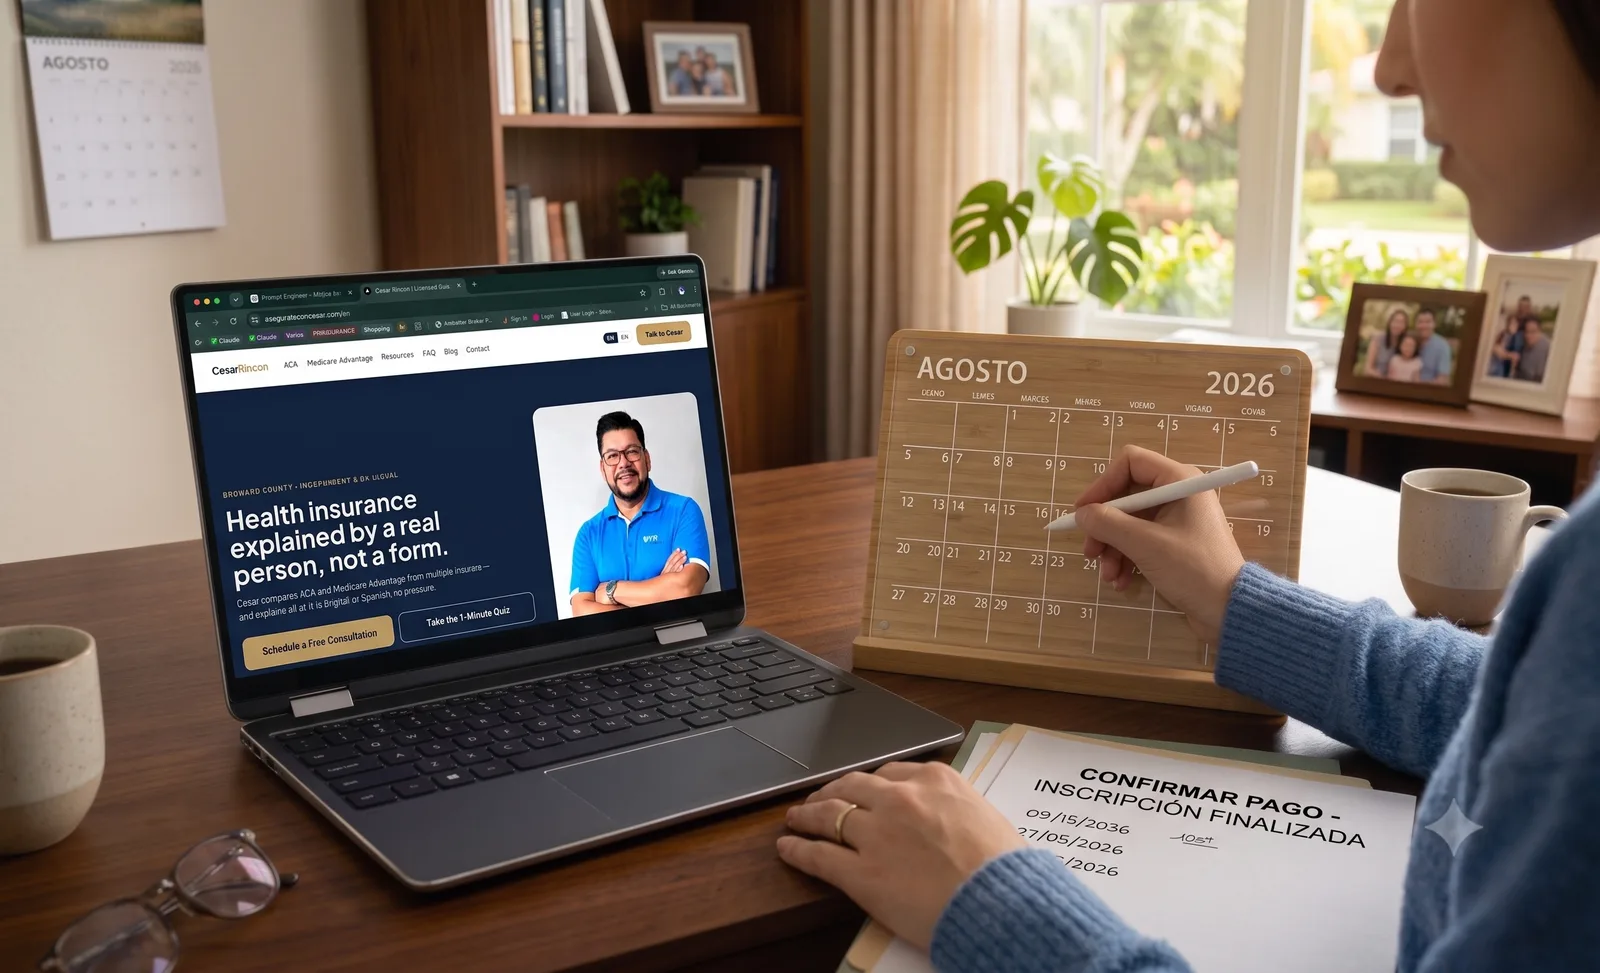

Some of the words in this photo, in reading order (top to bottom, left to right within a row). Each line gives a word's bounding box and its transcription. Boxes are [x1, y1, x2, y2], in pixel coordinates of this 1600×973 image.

[43, 56, 109, 71] AGOSTO
[283, 292, 308, 300] Engineer
[391, 285, 410, 293] Rincon
[218, 336, 240, 344] Claude
[256, 333, 277, 341] Claude
[285, 331, 304, 339] Varios
[363, 325, 391, 333] Shopping
[307, 358, 337, 366] Medicare
[339, 355, 373, 364] Advantage
[381, 351, 414, 360] Resources
[422, 349, 436, 357] FAQ
[444, 348, 458, 356] Blog
[465, 345, 490, 353] Contact
[212, 363, 269, 375] CesarRincon
[917, 356, 1027, 384] AGOSTO
[1205, 371, 1274, 397] 2026
[972, 392, 995, 400] LEMES
[1021, 394, 1049, 403] MARCES
[1049, 411, 1056, 423] 2
[1063, 412, 1070, 423] 2
[1102, 415, 1109, 426] 3
[1117, 416, 1123, 427] 3
[1157, 419, 1164, 430] 4
[1172, 419, 1178, 431] 5
[1212, 423, 1220, 433] 4
[1228, 423, 1235, 434] 5
[1270, 426, 1277, 437] 5
[904, 449, 911, 460] 5
[942, 452, 949, 463] 6
[956, 453, 963, 464] 7
[993, 456, 1000, 467] 8
[1006, 456, 1013, 467] 8
[1045, 459, 1052, 470] 9
[1059, 460, 1066, 471] 9
[1093, 463, 1106, 474] 10
[1260, 475, 1274, 486] 13
[222, 488, 260, 498] BROWARD
[262, 484, 293, 494] COUNTY
[226, 503, 304, 532] Health
[308, 493, 417, 522] insurance
[901, 496, 914, 507] 12
[933, 499, 945, 510] 13
[952, 500, 965, 511] 14
[984, 503, 996, 514] 14
[1003, 504, 1015, 515] 15
[1035, 507, 1048, 518] 16
[1257, 525, 1270, 537] 19
[230, 523, 345, 560] explained
[349, 522, 378, 546] by
[382, 521, 396, 538] a
[399, 510, 441, 536] real
[234, 559, 324, 592] person,
[329, 549, 368, 572] not
[372, 549, 385, 566] a
[388, 541, 448, 563] form.
[896, 542, 910, 554] 20
[927, 545, 941, 557] 20
[947, 547, 959, 558] 21
[978, 549, 990, 561] 21
[998, 551, 1012, 563] 22
[1030, 554, 1044, 566] 23
[1050, 556, 1065, 567] 23
[1083, 558, 1097, 570] 24
[236, 598, 259, 608] Cesar
[260, 592, 299, 604] compares
[300, 588, 316, 598] ACA
[317, 586, 331, 596] and
[333, 581, 367, 593] Medicare
[368, 575, 406, 588] Advantage
[407, 573, 424, 582] from
[425, 567, 454, 579] multiple
[239, 611, 254, 622] and
[288, 604, 297, 614] all
[298, 604, 307, 612] at
[308, 602, 314, 610] it
[315, 601, 323, 609] is
[361, 591, 393, 603] Spanish,
[393, 589, 403, 597] no
[404, 584, 437, 597] pressure.
[892, 589, 905, 600] 27
[923, 592, 936, 604] 27
[943, 594, 956, 605] 28
[974, 597, 988, 608] 28
[994, 599, 1007, 610] 29
[1026, 602, 1039, 614] 30
[1046, 604, 1060, 616] 30
[1080, 607, 1092, 619] 31
[426, 617, 445, 627] Take
[446, 615, 458, 624] the
[459, 610, 492, 622] 1-Minute
[493, 606, 511, 616] Quiz
[262, 642, 300, 656] Schedule
[308, 639, 326, 648] Free
[327, 630, 378, 644] Consultation
[1080, 768, 1239, 806] CONFIRMAR
[1245, 794, 1323, 820] PAGO
[1026, 809, 1130, 835] 09/15/2036
[1034, 779, 1202, 819] INSCRIPCIÓN
[1209, 809, 1366, 849] FINALIZADA
[1018, 827, 1123, 855] 27/05/2026
[1056, 855, 1118, 877] /2026
